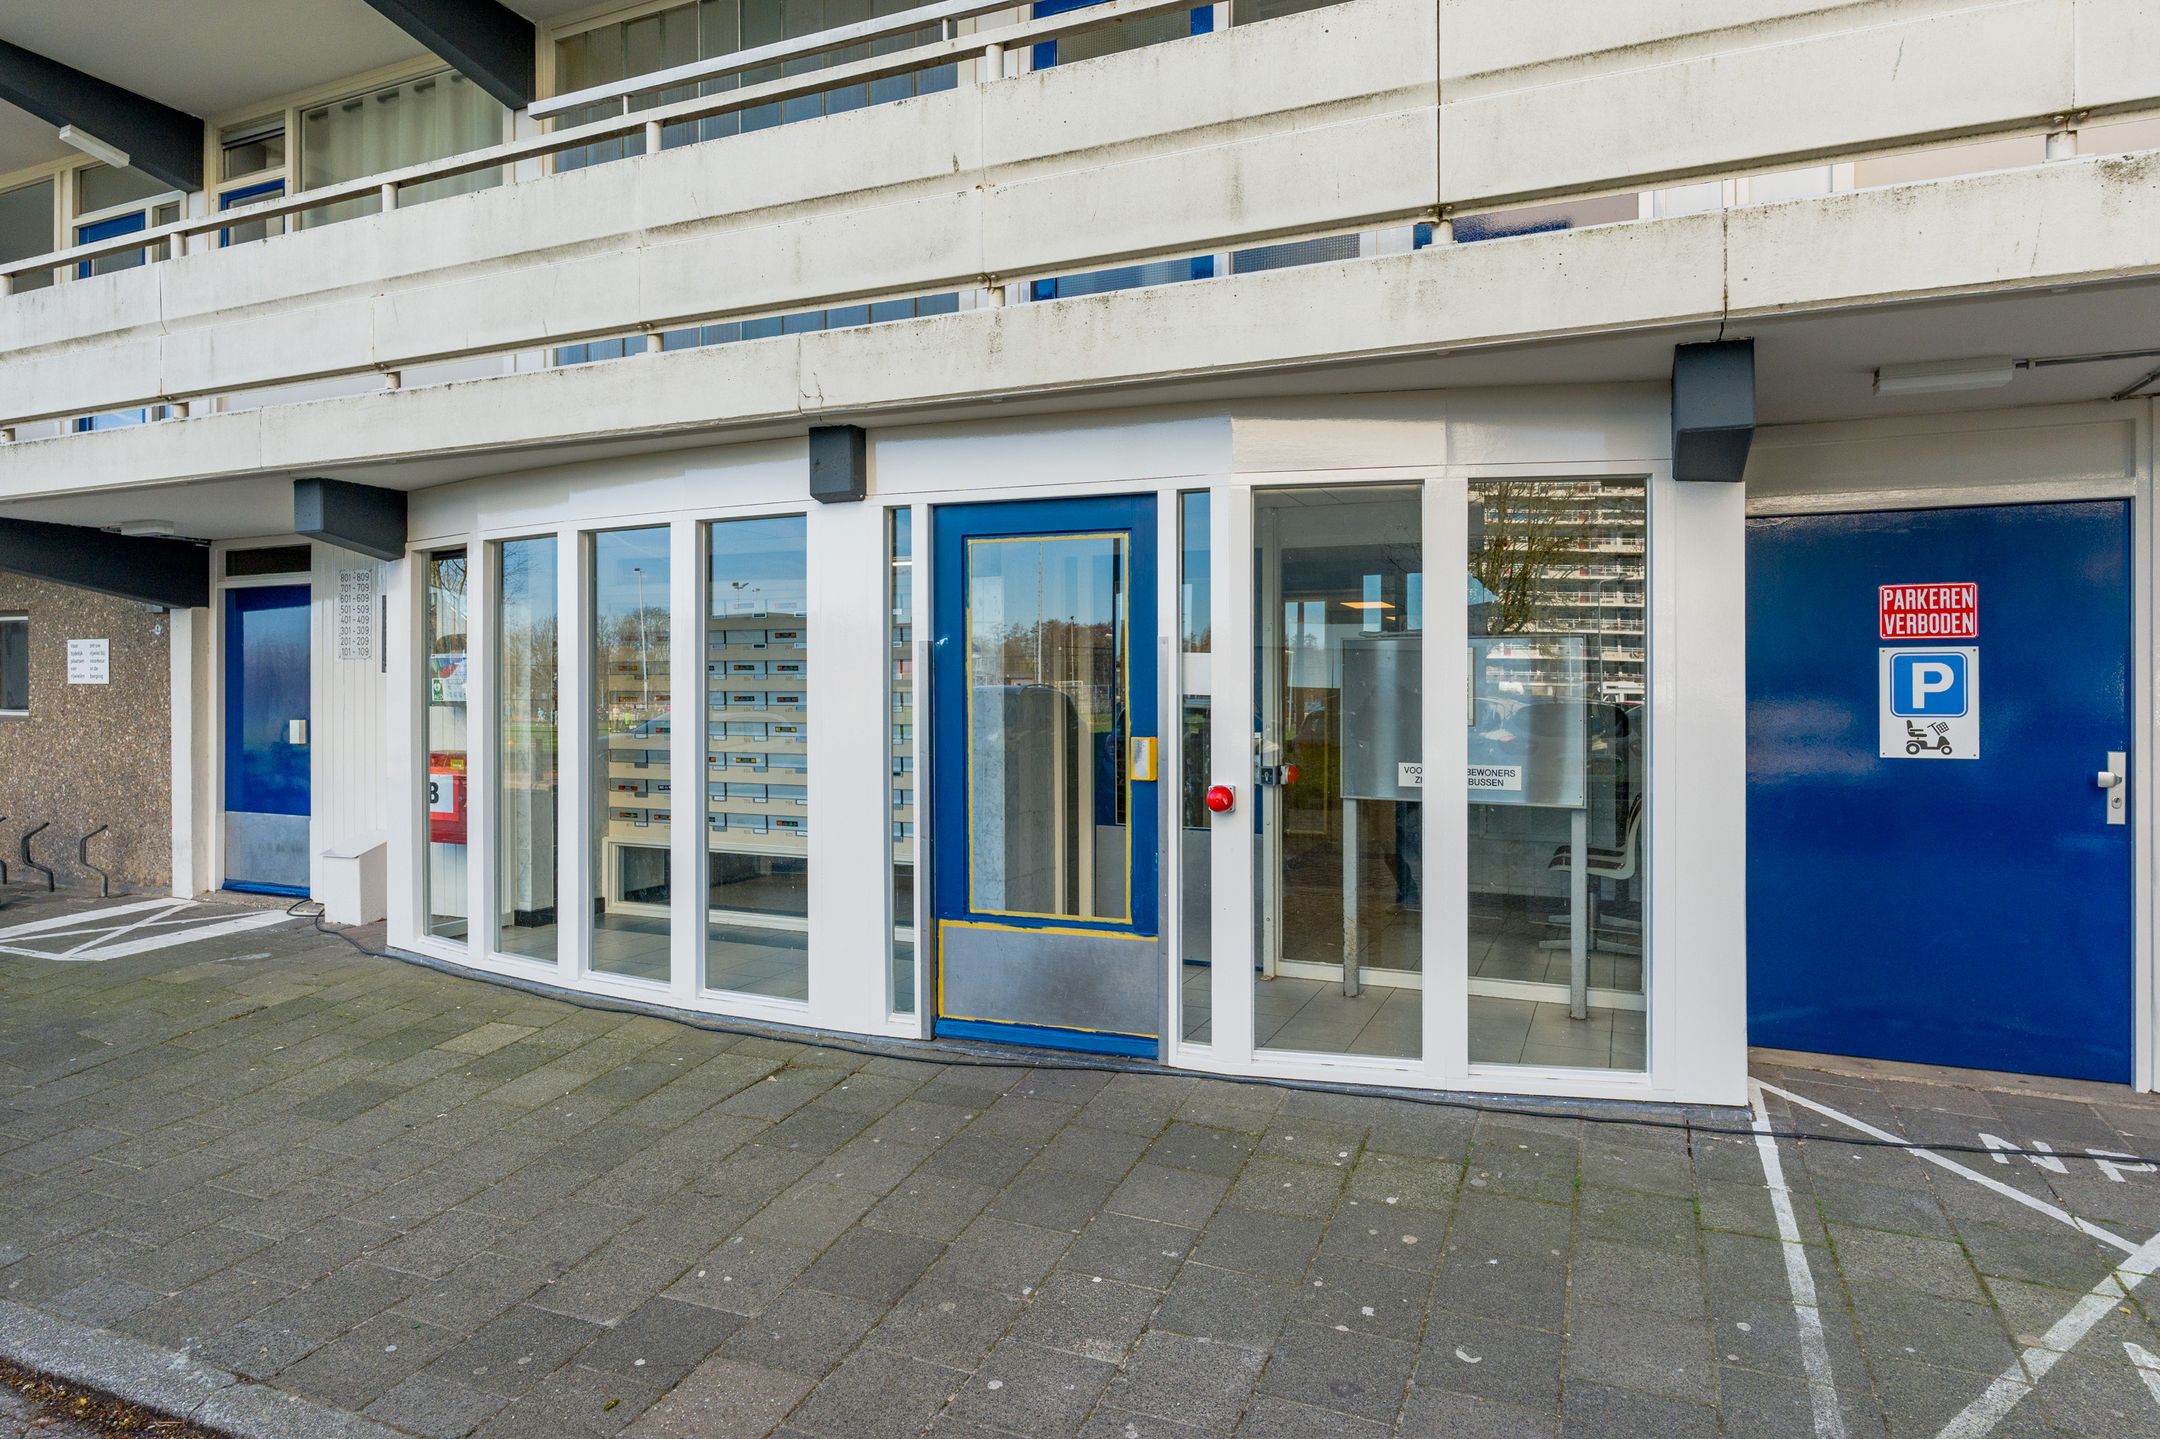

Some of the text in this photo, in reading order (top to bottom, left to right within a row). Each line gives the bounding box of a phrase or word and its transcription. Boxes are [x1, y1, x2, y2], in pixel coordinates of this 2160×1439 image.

[340, 574, 351, 582] 801
[357, 572, 369, 581] 809
[340, 584, 351, 592] 701
[357, 583, 369, 592] 709
[340, 594, 351, 603] 601
[357, 594, 369, 602] 609
[1883, 587, 1974, 610] PARKEREN
[340, 605, 351, 614] 501
[357, 604, 369, 614] 509
[340, 616, 351, 624] 401
[357, 616, 369, 624] 409
[1884, 612, 1974, 635] VERBODEN
[340, 626, 351, 635] 301
[357, 626, 369, 634] 309
[340, 637, 351, 646] 201
[357, 637, 369, 646] 209
[342, 648, 351, 656] 101
[358, 648, 369, 656] 109
[1912, 662, 1954, 709] P
[1404, 766, 1422, 774] VOO
